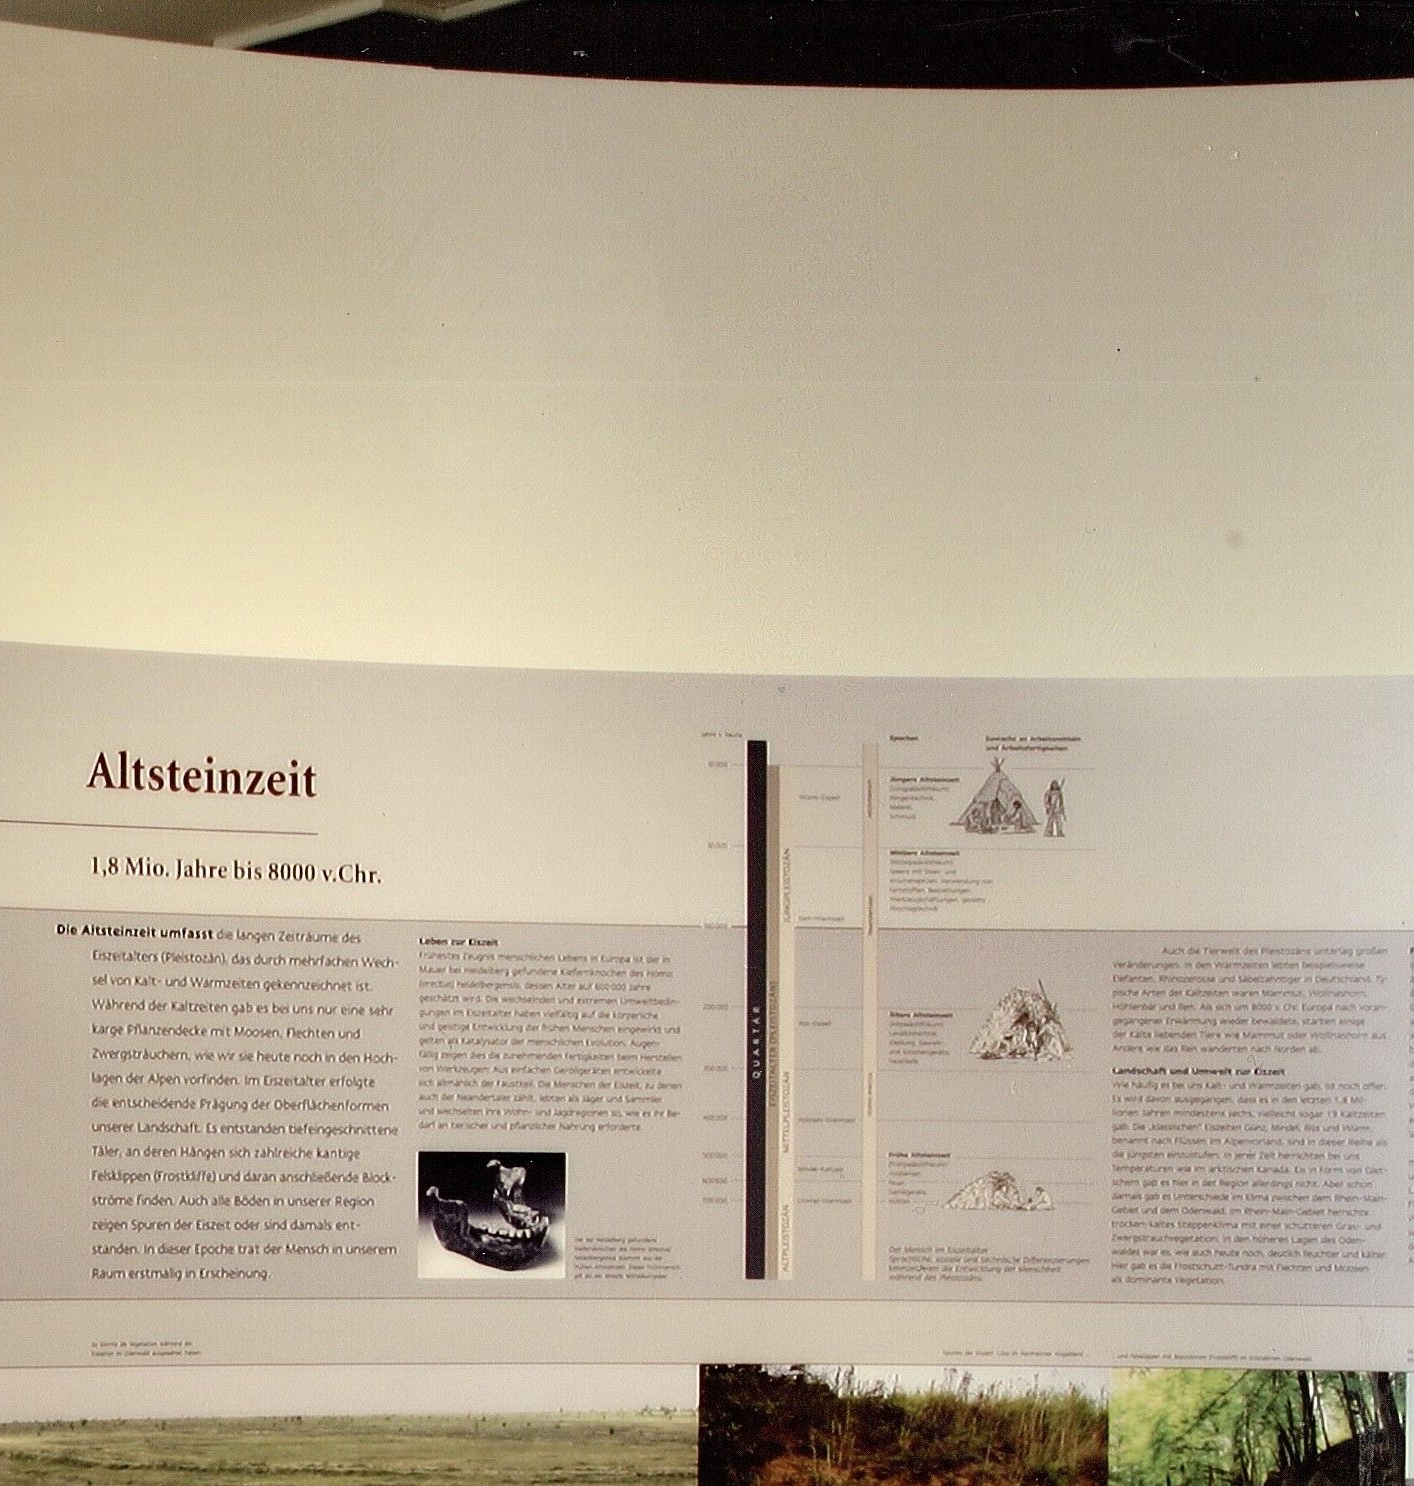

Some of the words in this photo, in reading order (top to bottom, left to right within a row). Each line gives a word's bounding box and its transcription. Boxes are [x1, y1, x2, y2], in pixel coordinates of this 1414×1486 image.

[87, 750, 316, 798] Altsteinzeit
[93, 854, 118, 877] 1,8
[126, 854, 168, 877] Mio.
[177, 856, 227, 880] Jahre
[234, 857, 261, 879] bis
[269, 858, 315, 881] 8000
[57, 923, 77, 935] Die
[82, 923, 155, 937] Altsteinzeit
[161, 925, 213, 938] umfasst
[217, 927, 232, 939] die
[237, 927, 274, 943] langen
[279, 929, 337, 941] Zeiträume
[343, 930, 362, 942] des
[419, 936, 448, 946] Leben
[93, 949, 158, 961] Eiszeitalters
[232, 952, 251, 964] das
[254, 952, 286, 964] durch
[289, 953, 358, 966] mehrfachen
[92, 974, 107, 985] sel
[110, 978, 131, 986] von
[135, 974, 161, 986] Kalt-
[165, 975, 187, 987] und
[190, 976, 260, 988] Warmzeiten
[92, 998, 145, 1011] Während
[148, 999, 167, 1011] der
[171, 1000, 228, 1012] Kaltzeiten
[232, 1001, 253, 1016] gab
[256, 1005, 268, 1013] es
[272, 1001, 289, 1013] bei
[293, 1006, 313, 1014] uns
[317, 1006, 336, 1014] nur
[341, 1003, 364, 1014] eine
[369, 1003, 395, 1015] sehr
[92, 1022, 123, 1038] karge
[211, 1024, 230, 1036] mit
[287, 1026, 335, 1038] Flechten
[338, 1027, 362, 1038] und
[195, 1049, 214, 1060] wie
[218, 1049, 234, 1061] wir
[239, 1049, 253, 1061] sie
[257, 1049, 290, 1061] heute
[294, 1050, 322, 1062] noch
[325, 1050, 335, 1062] in
[339, 1051, 360, 1062] den
[364, 1051, 398, 1063] Hoch-
[1112, 1066, 1166, 1075] Landschaft
[1170, 1066, 1189, 1075] und
[91, 1071, 123, 1087] lagen
[126, 1072, 144, 1083] der
[148, 1072, 180, 1087] Alpen
[244, 1073, 260, 1085] Im
[264, 1074, 325, 1086] Eiszeitalter
[330, 1075, 375, 1090] erfolgte
[91, 1096, 109, 1108] die
[112, 1097, 196, 1109] entscheidende
[200, 1098, 248, 1113] Prägung
[252, 1098, 269, 1110] der
[274, 1098, 390, 1111] Oberflächenformen
[91, 1124, 134, 1132] unserer
[206, 1122, 217, 1133] Es
[221, 1122, 285, 1134] entstanden
[126, 1149, 140, 1157] an
[143, 1146, 177, 1157] deren
[180, 1146, 225, 1161] Hängen
[229, 1146, 250, 1158] sich
[255, 1146, 312, 1158] zahlreiche
[317, 1147, 361, 1162] kantige
[219, 1170, 240, 1182] und
[244, 1170, 276, 1182] daran
[363, 1171, 397, 1182] Block-
[91, 1194, 133, 1205] ströme
[179, 1194, 208, 1206] Auch
[212, 1194, 230, 1206] alle
[234, 1194, 270, 1206] Böden
[273, 1194, 284, 1206] in
[288, 1198, 330, 1206] unserer
[335, 1195, 375, 1210] Region
[92, 1218, 128, 1233] zeigen
[131, 1218, 171, 1233] Spuren
[174, 1218, 192, 1230] der
[196, 1218, 230, 1230] Eiszeit
[234, 1218, 259, 1230] oder
[264, 1219, 287, 1230] sind
[290, 1219, 332, 1230] damals
[336, 1219, 361, 1230] ent-
[144, 1242, 155, 1254] In
[158, 1242, 191, 1254] dieser
[195, 1242, 234, 1257] Epoche
[238, 1242, 259, 1254] trat
[263, 1242, 281, 1254] der
[286, 1243, 329, 1254] Mensch
[332, 1243, 342, 1254] in
[346, 1246, 398, 1254] unserem
[92, 1267, 125, 1278] Raum
[129, 1267, 182, 1282] erstmalig
[185, 1267, 196, 1278] in
